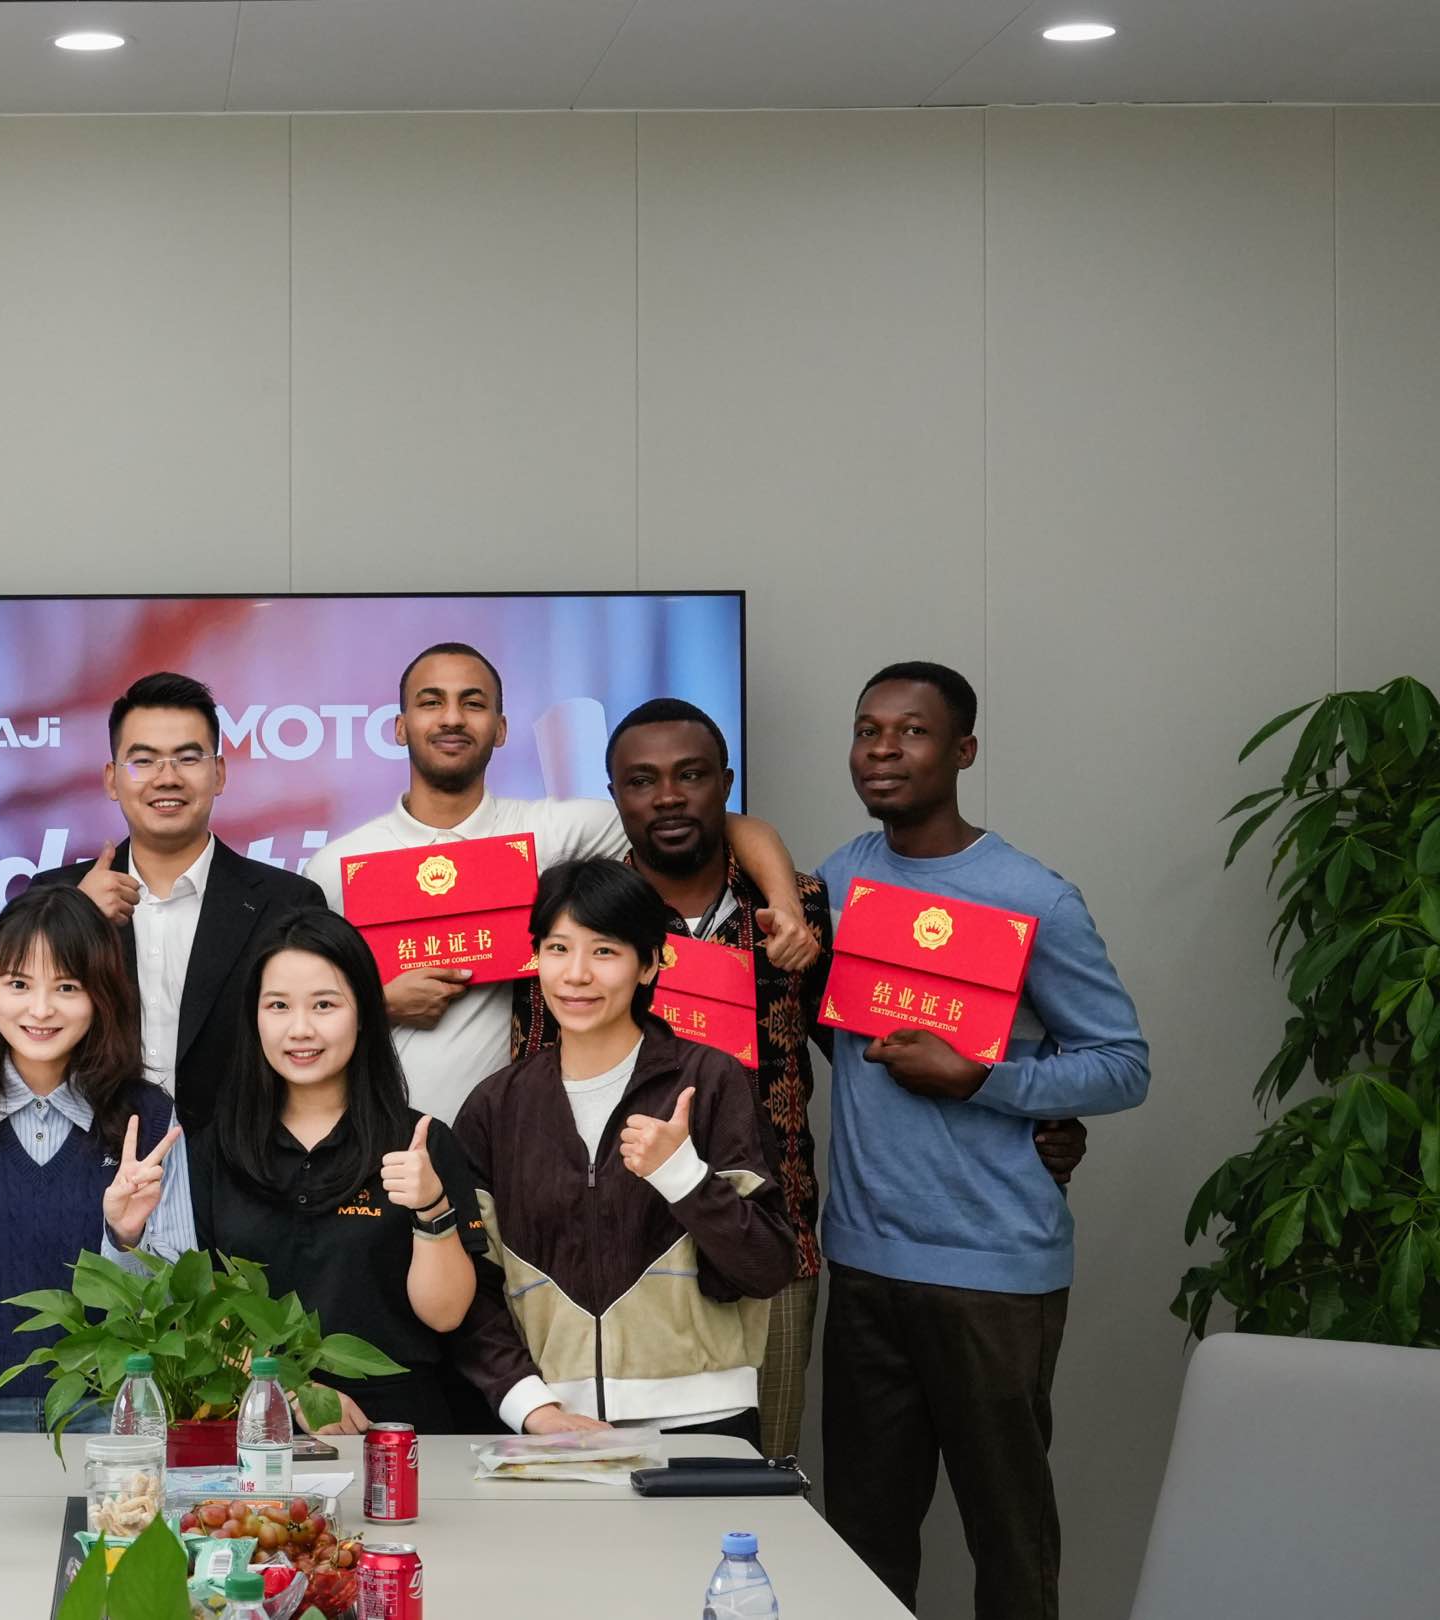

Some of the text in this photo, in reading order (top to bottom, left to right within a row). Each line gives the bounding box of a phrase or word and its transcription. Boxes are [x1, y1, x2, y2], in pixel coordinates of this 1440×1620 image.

[398, 929, 492, 960] 结业证书
[400, 960, 440, 970] CERTIFICATE
[451, 953, 493, 964] COMPLETION
[872, 981, 964, 1021] 结业证书
[870, 1005, 958, 1032] CERTIFICATE OF COMPLETION
